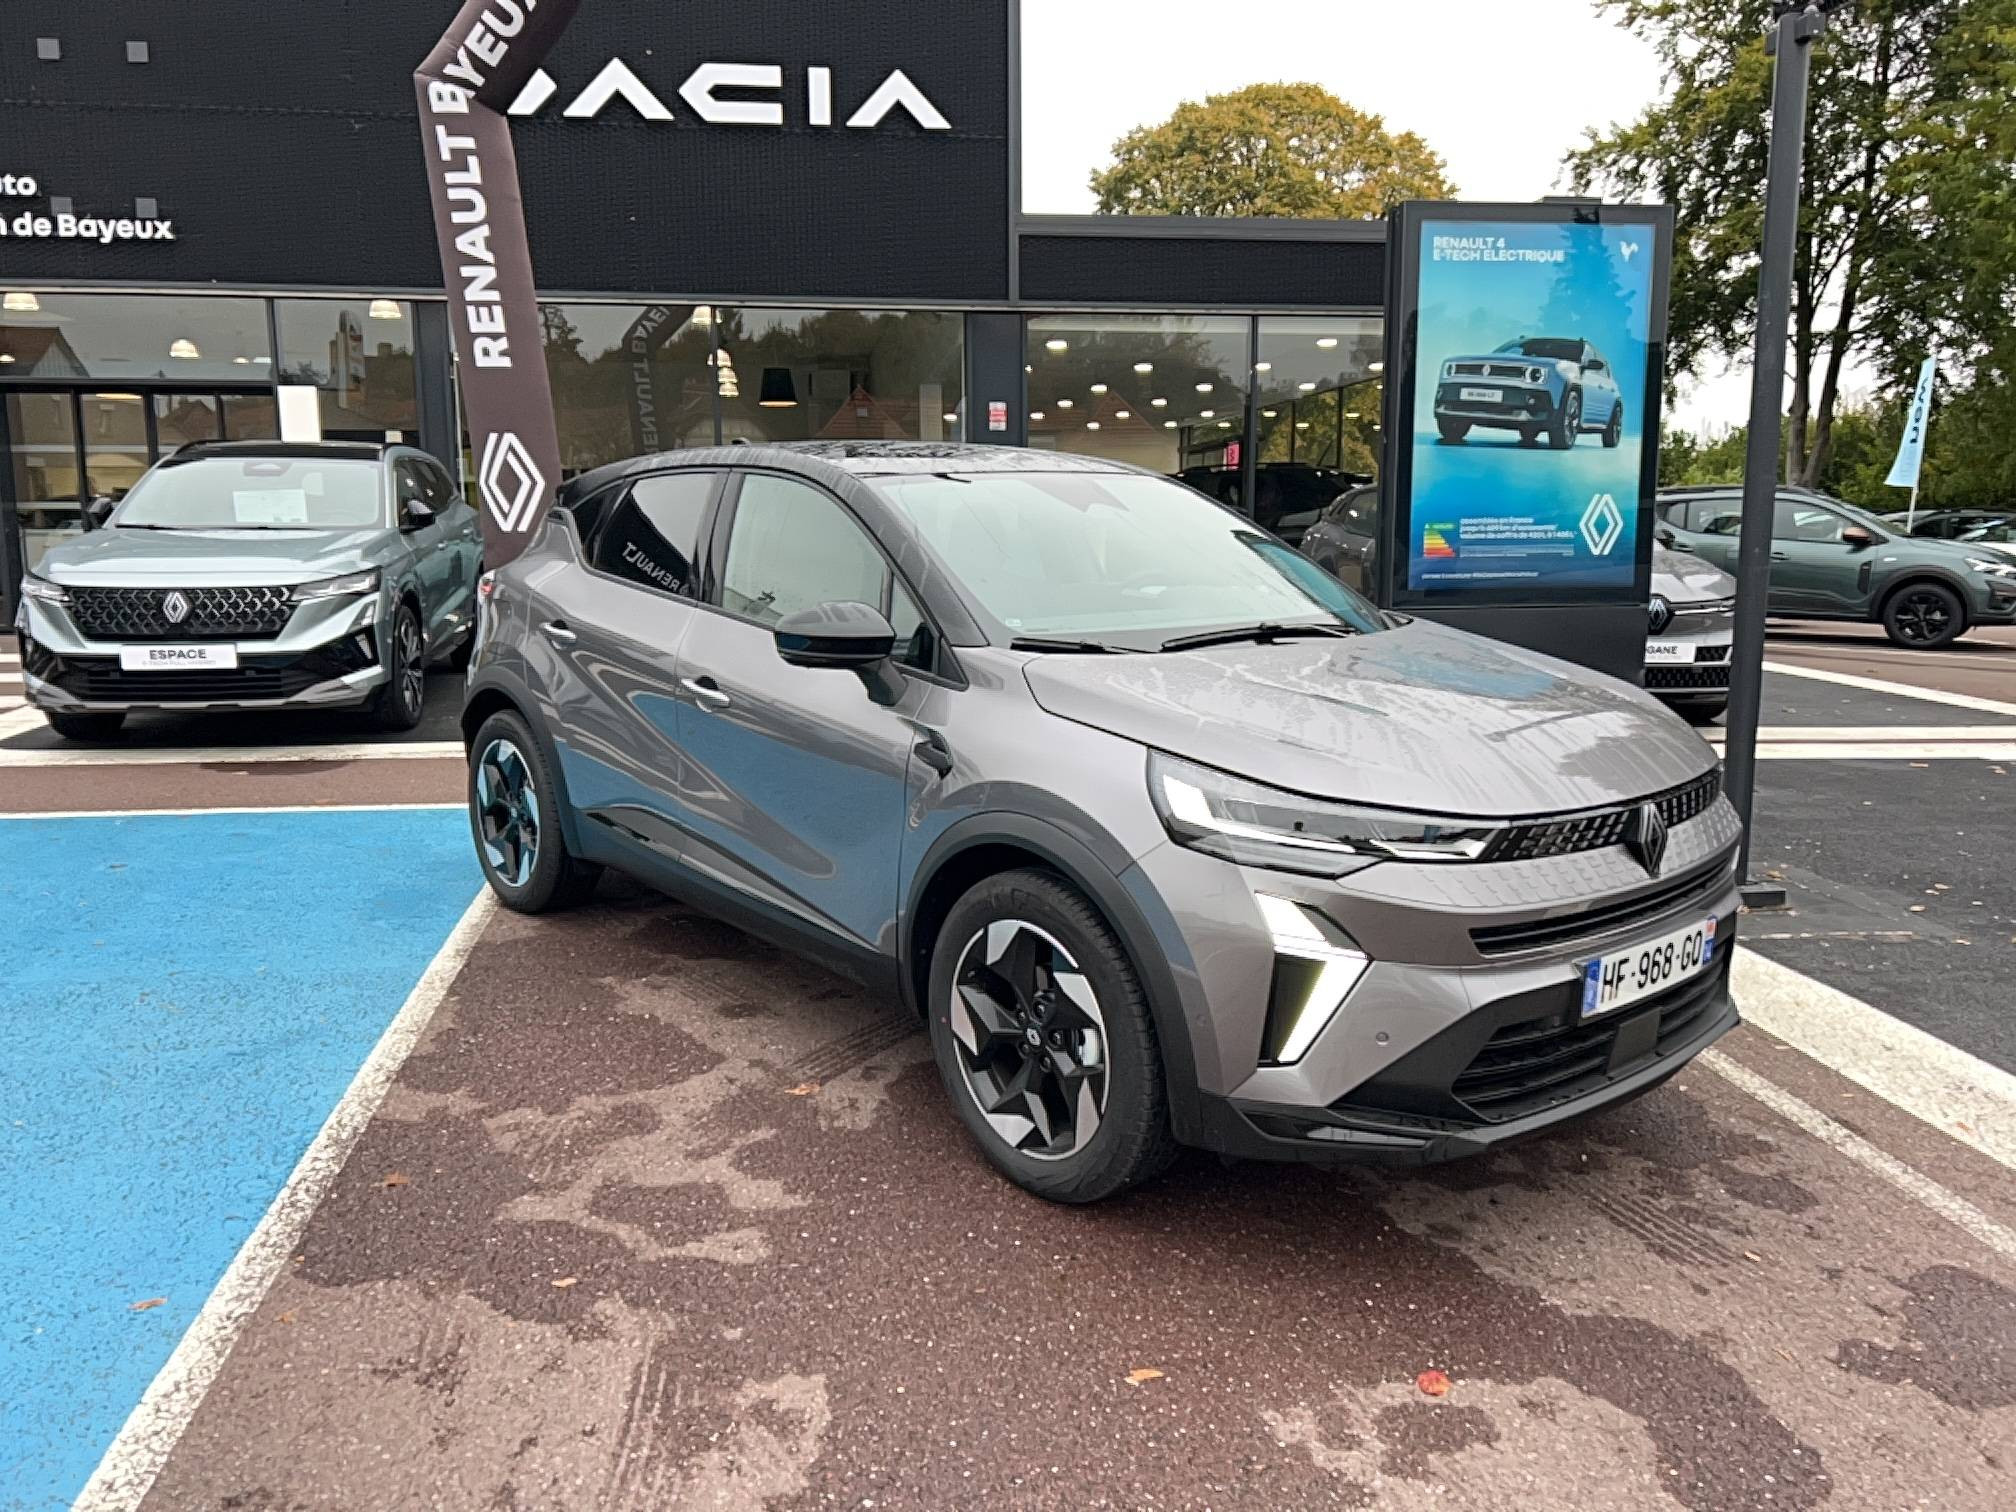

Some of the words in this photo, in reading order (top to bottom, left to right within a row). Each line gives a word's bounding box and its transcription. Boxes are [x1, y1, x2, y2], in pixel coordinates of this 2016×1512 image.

[428, 0, 537, 113] BYEU
[0, 173, 38, 196] to
[13, 211, 51, 238] de
[57, 213, 175, 244] Bayeux
[435, 124, 512, 368] RENAULT
[1432, 236, 1494, 249] RENAULT
[1496, 238, 1505, 249] 4
[1432, 249, 1481, 261] E-TECH
[1483, 249, 1565, 263] ELECTRIQUE
[149, 649, 207, 660] ESPACE
